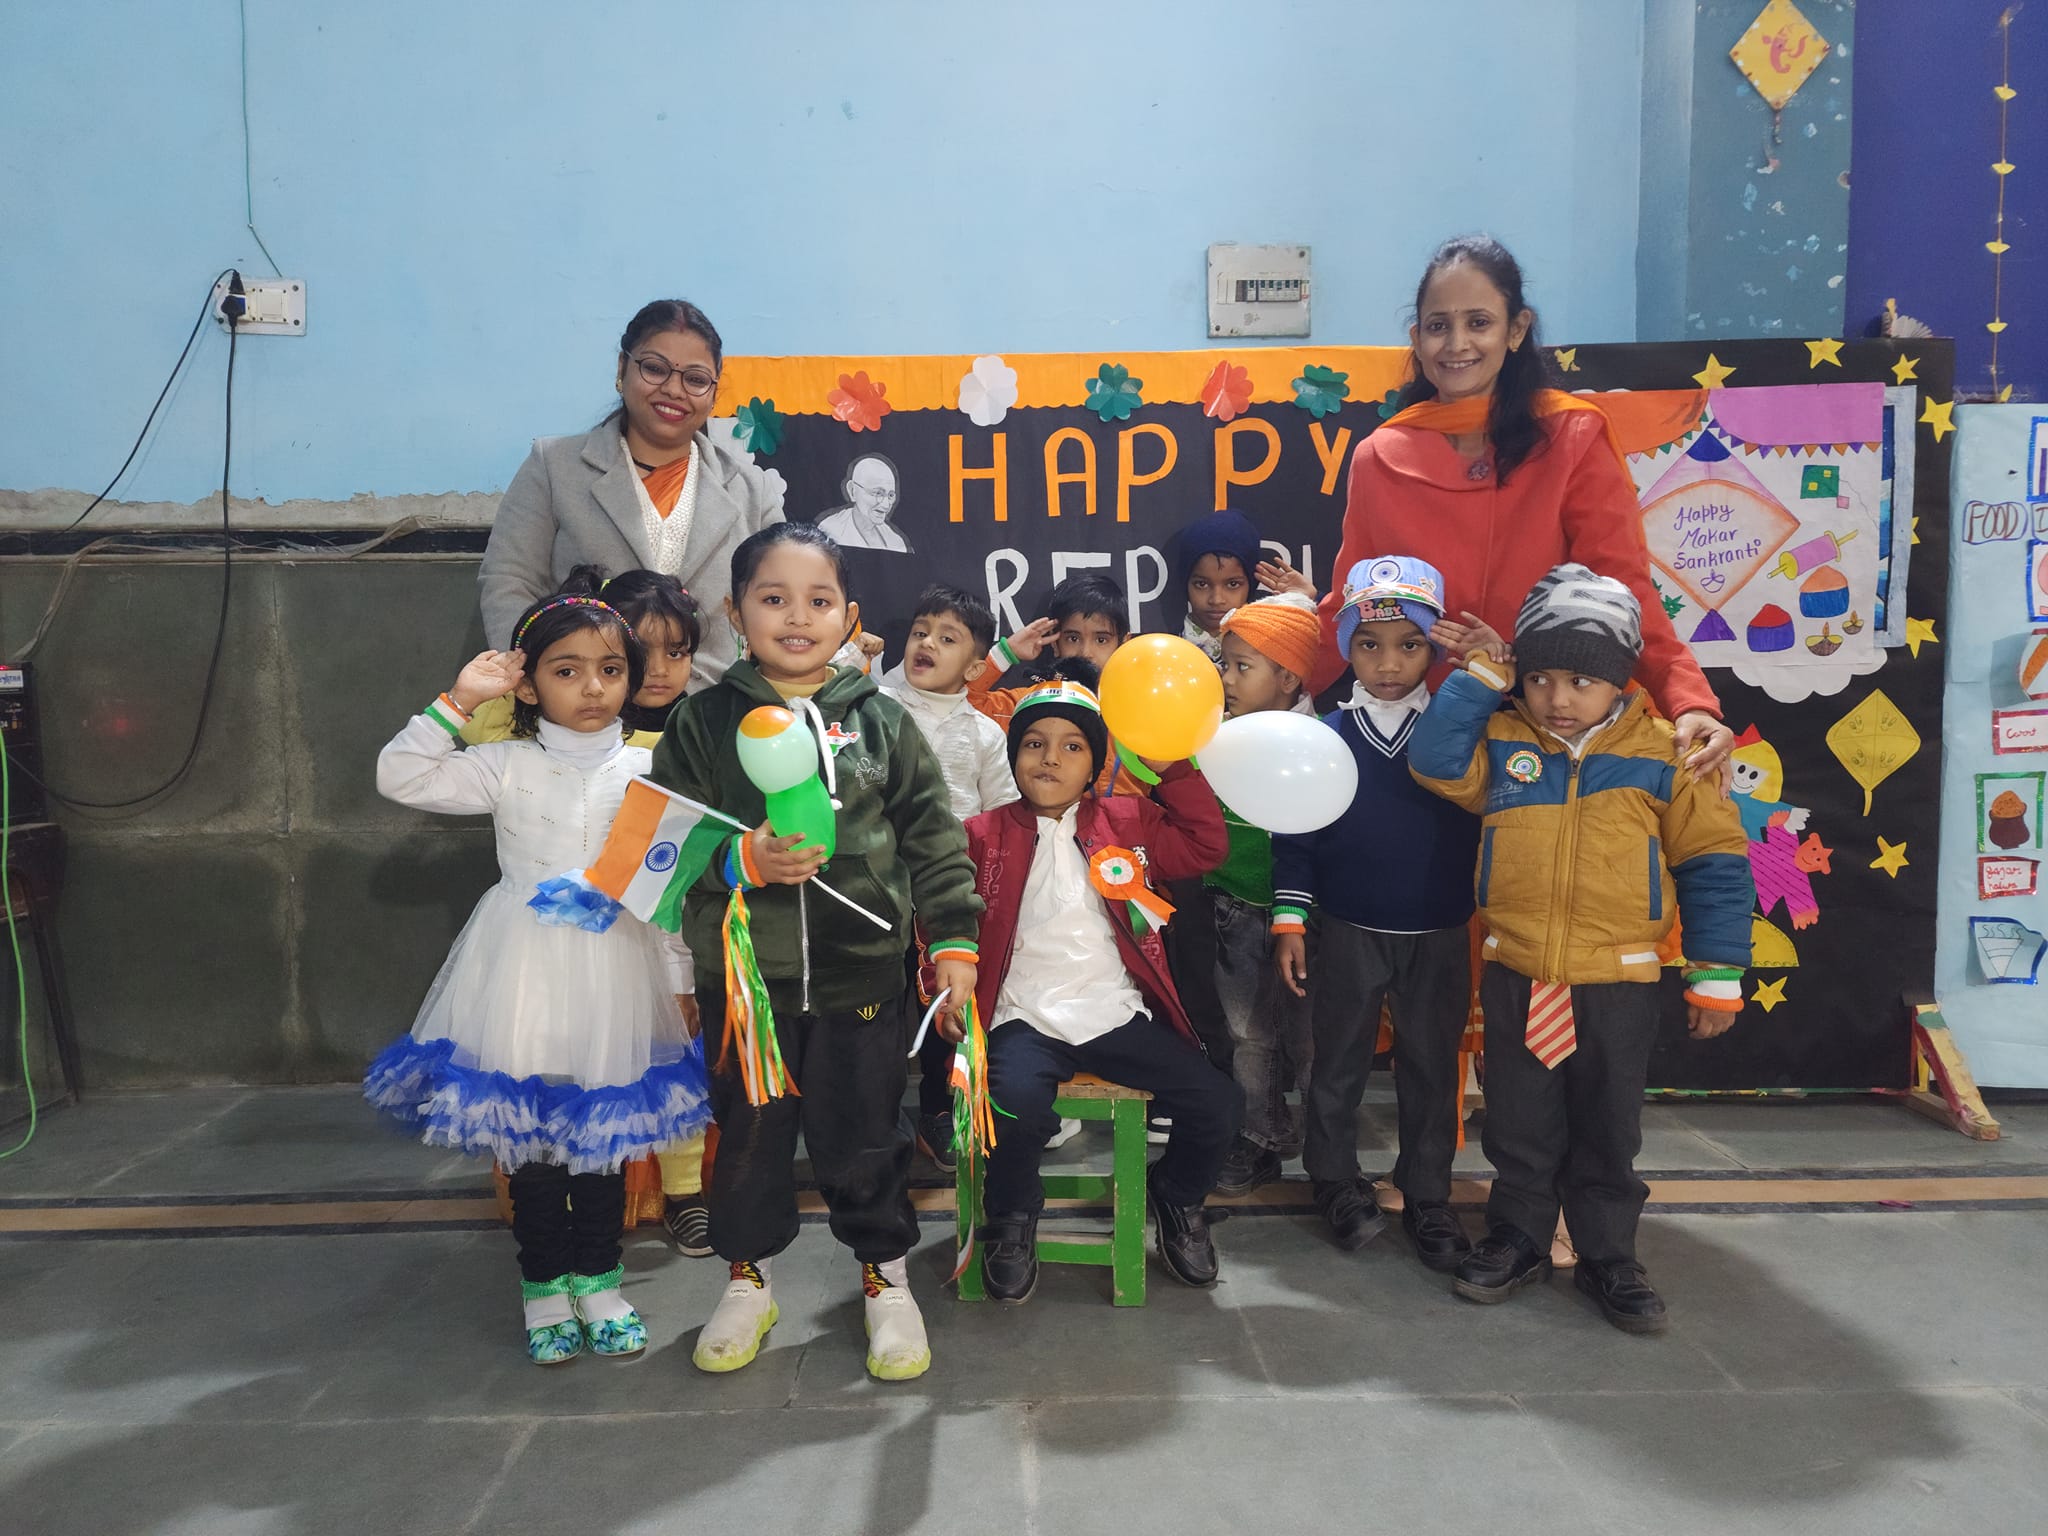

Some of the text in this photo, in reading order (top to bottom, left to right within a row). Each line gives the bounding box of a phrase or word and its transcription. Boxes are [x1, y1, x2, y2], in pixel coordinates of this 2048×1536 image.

[948, 417, 1353, 523] HAPPY
[1673, 503, 1735, 531] Happy
[1967, 502, 2019, 543] FOOD
[1679, 527, 1739, 550] Makar
[1673, 538, 1762, 570] Sankranti
[1356, 600, 1401, 619] BABY
